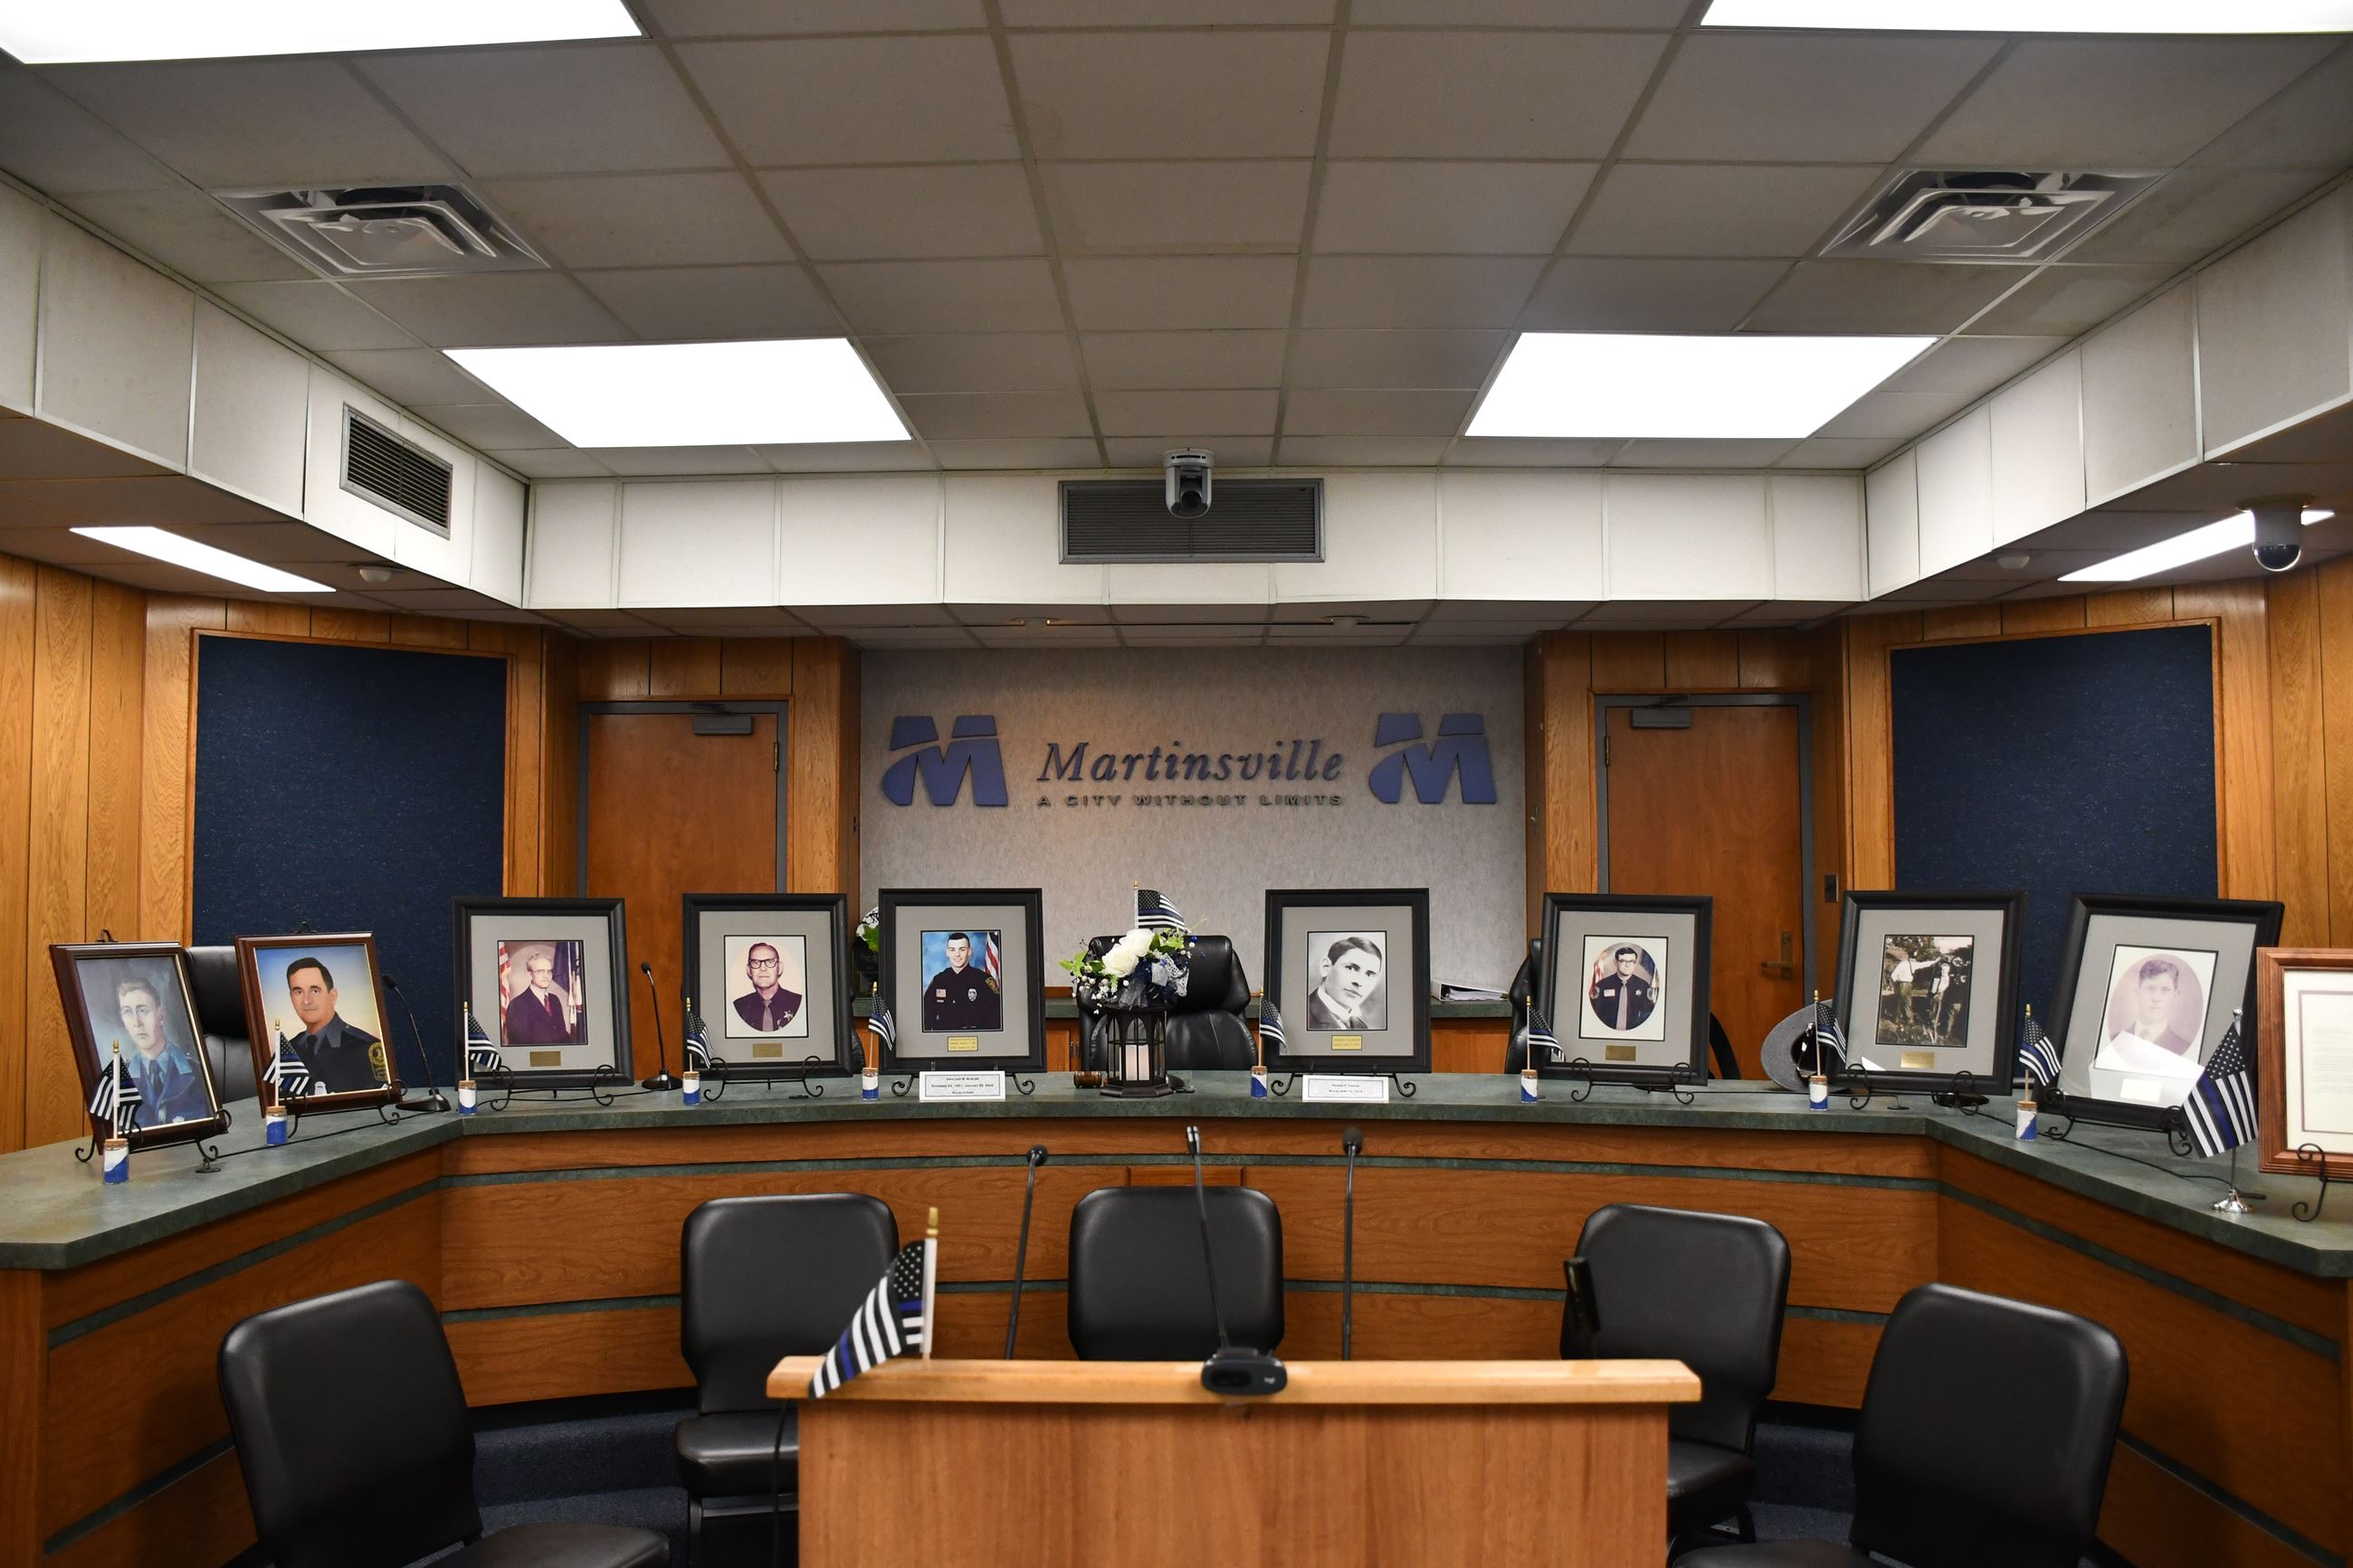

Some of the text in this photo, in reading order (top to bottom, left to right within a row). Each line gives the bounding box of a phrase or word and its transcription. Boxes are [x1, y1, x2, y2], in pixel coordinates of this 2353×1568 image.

[1036, 739, 1342, 782] Martinsville
[1037, 794, 1342, 807] A CITY WITHOUT LIMITS
